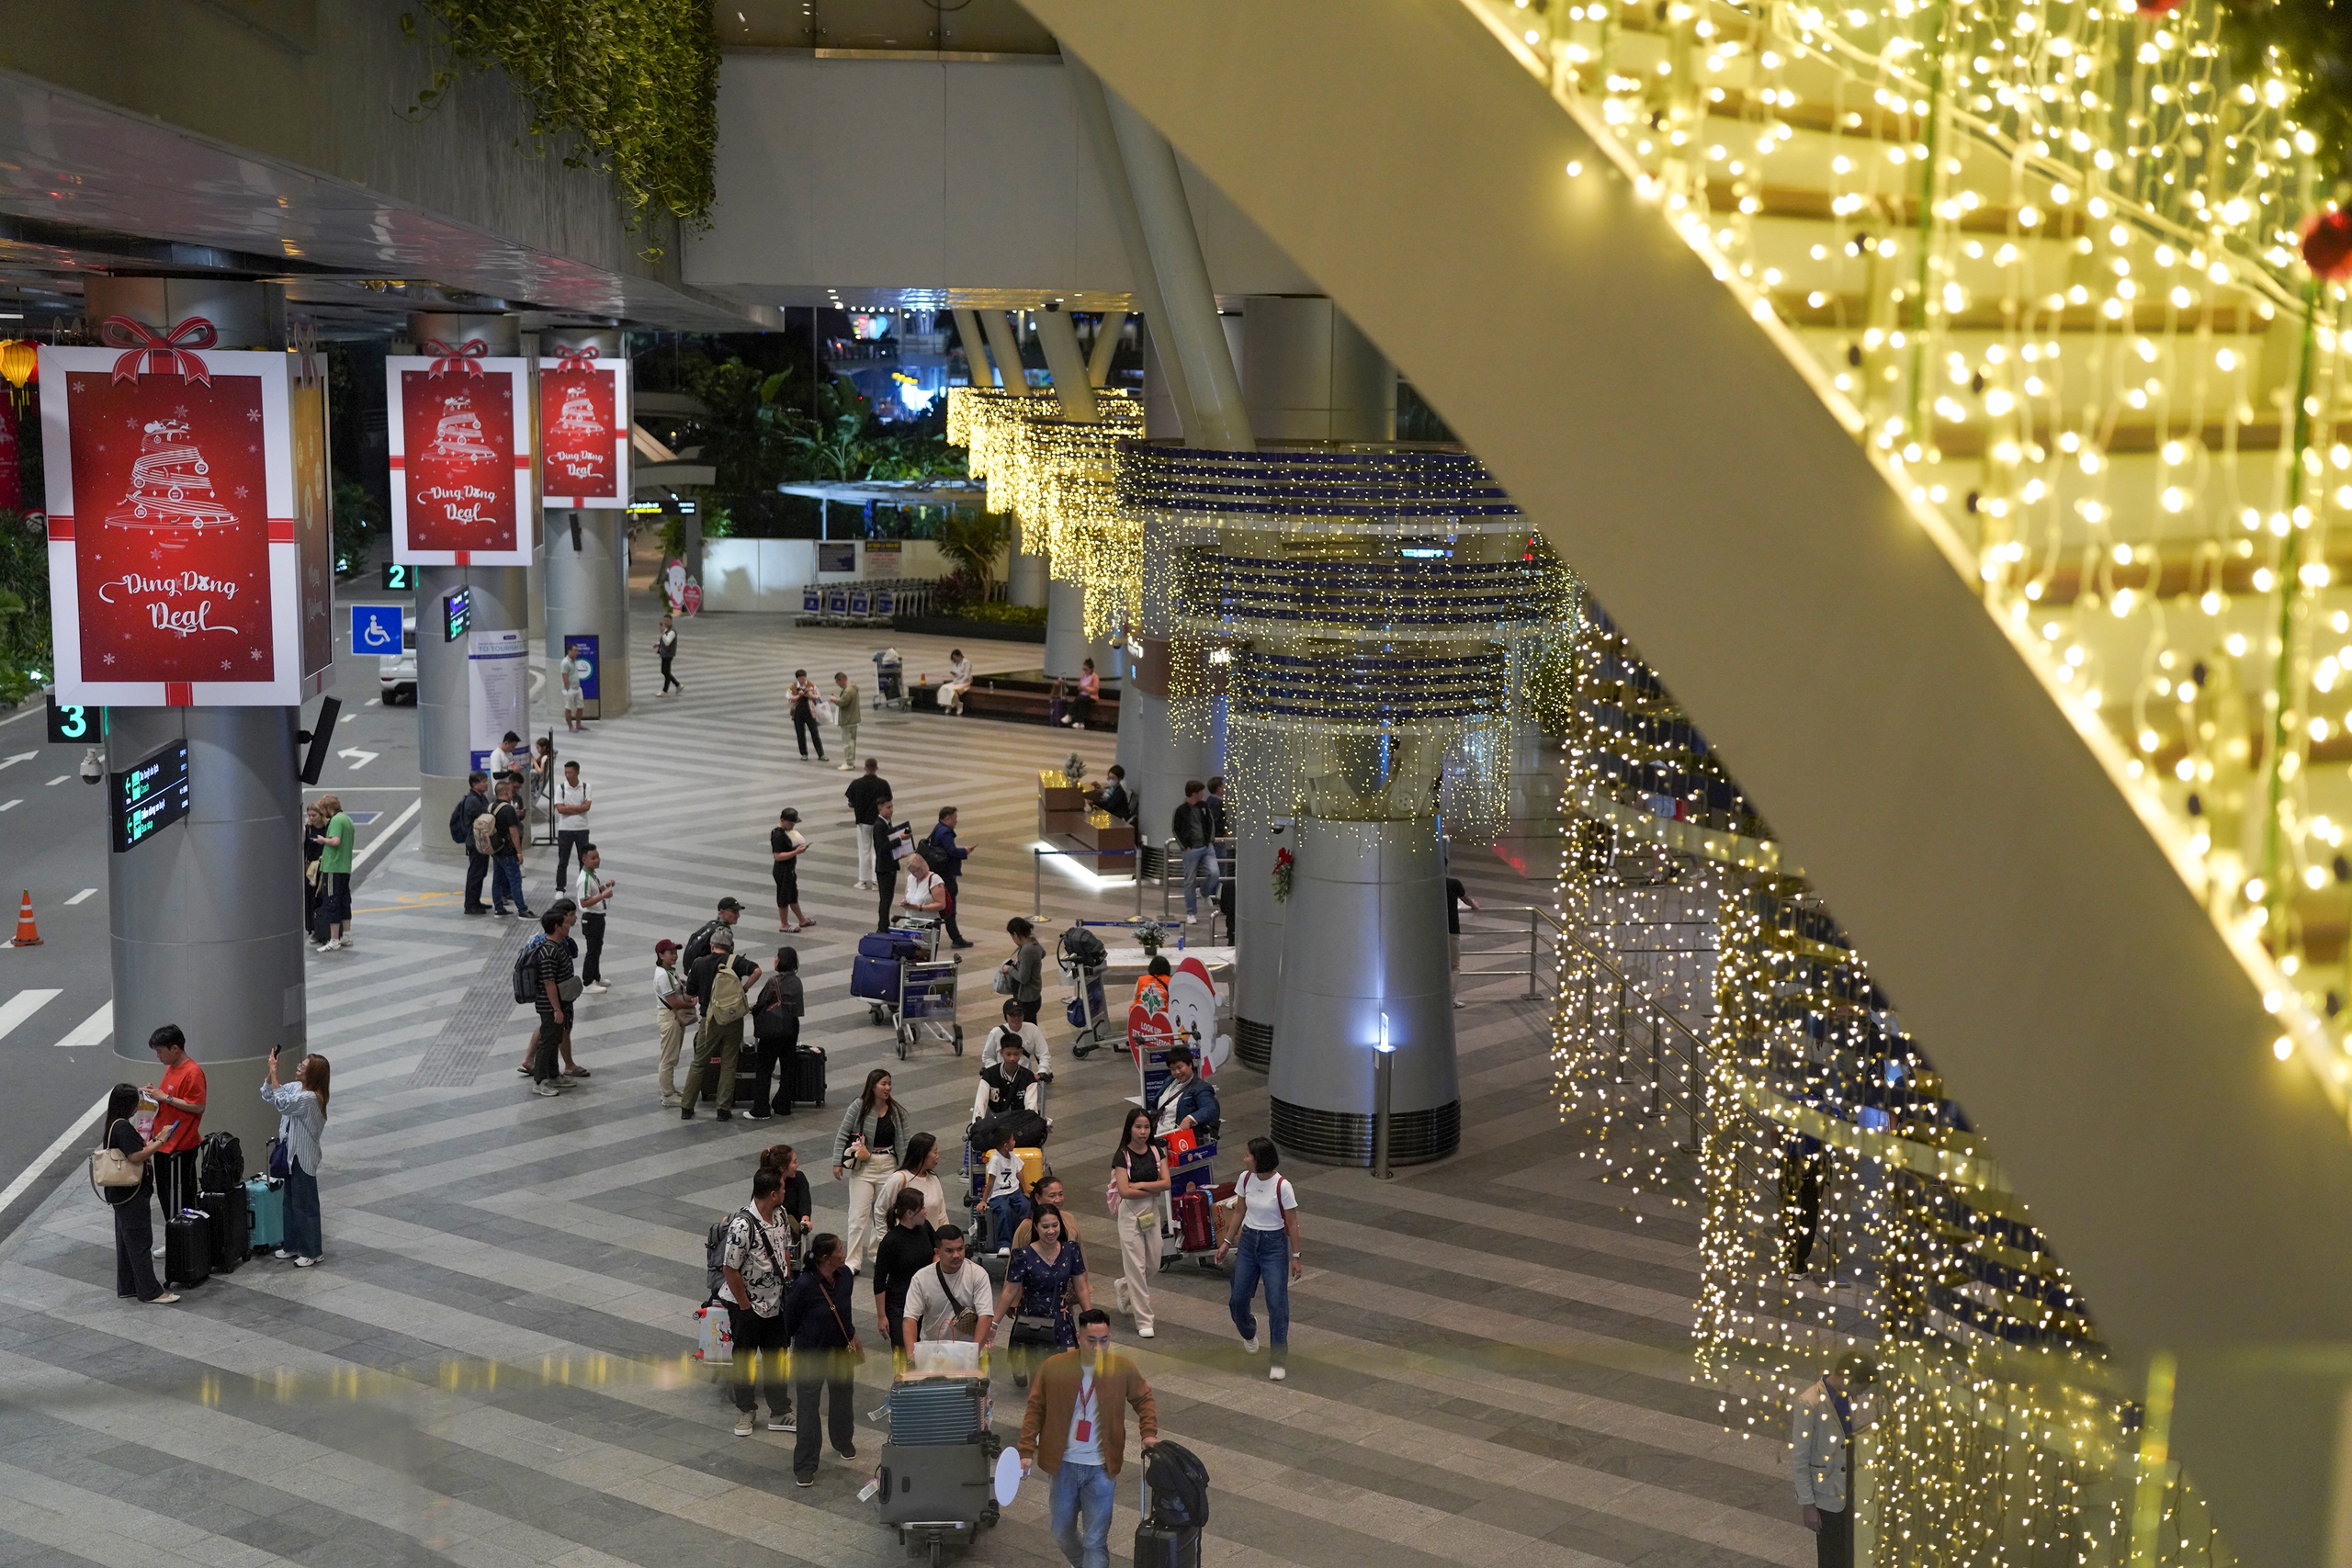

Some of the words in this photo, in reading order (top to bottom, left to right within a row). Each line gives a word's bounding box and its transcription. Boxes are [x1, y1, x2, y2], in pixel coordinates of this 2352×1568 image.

[417, 486, 465, 504] Ding
[443, 502, 496, 525] Deal
[389, 564, 405, 588] 2
[98, 572, 183, 604] Ding
[145, 600, 239, 637] Deal
[61, 705, 86, 738] 3
[1141, 1021, 1153, 1032] LOOK
[1001, 1171, 1012, 1183] 7
